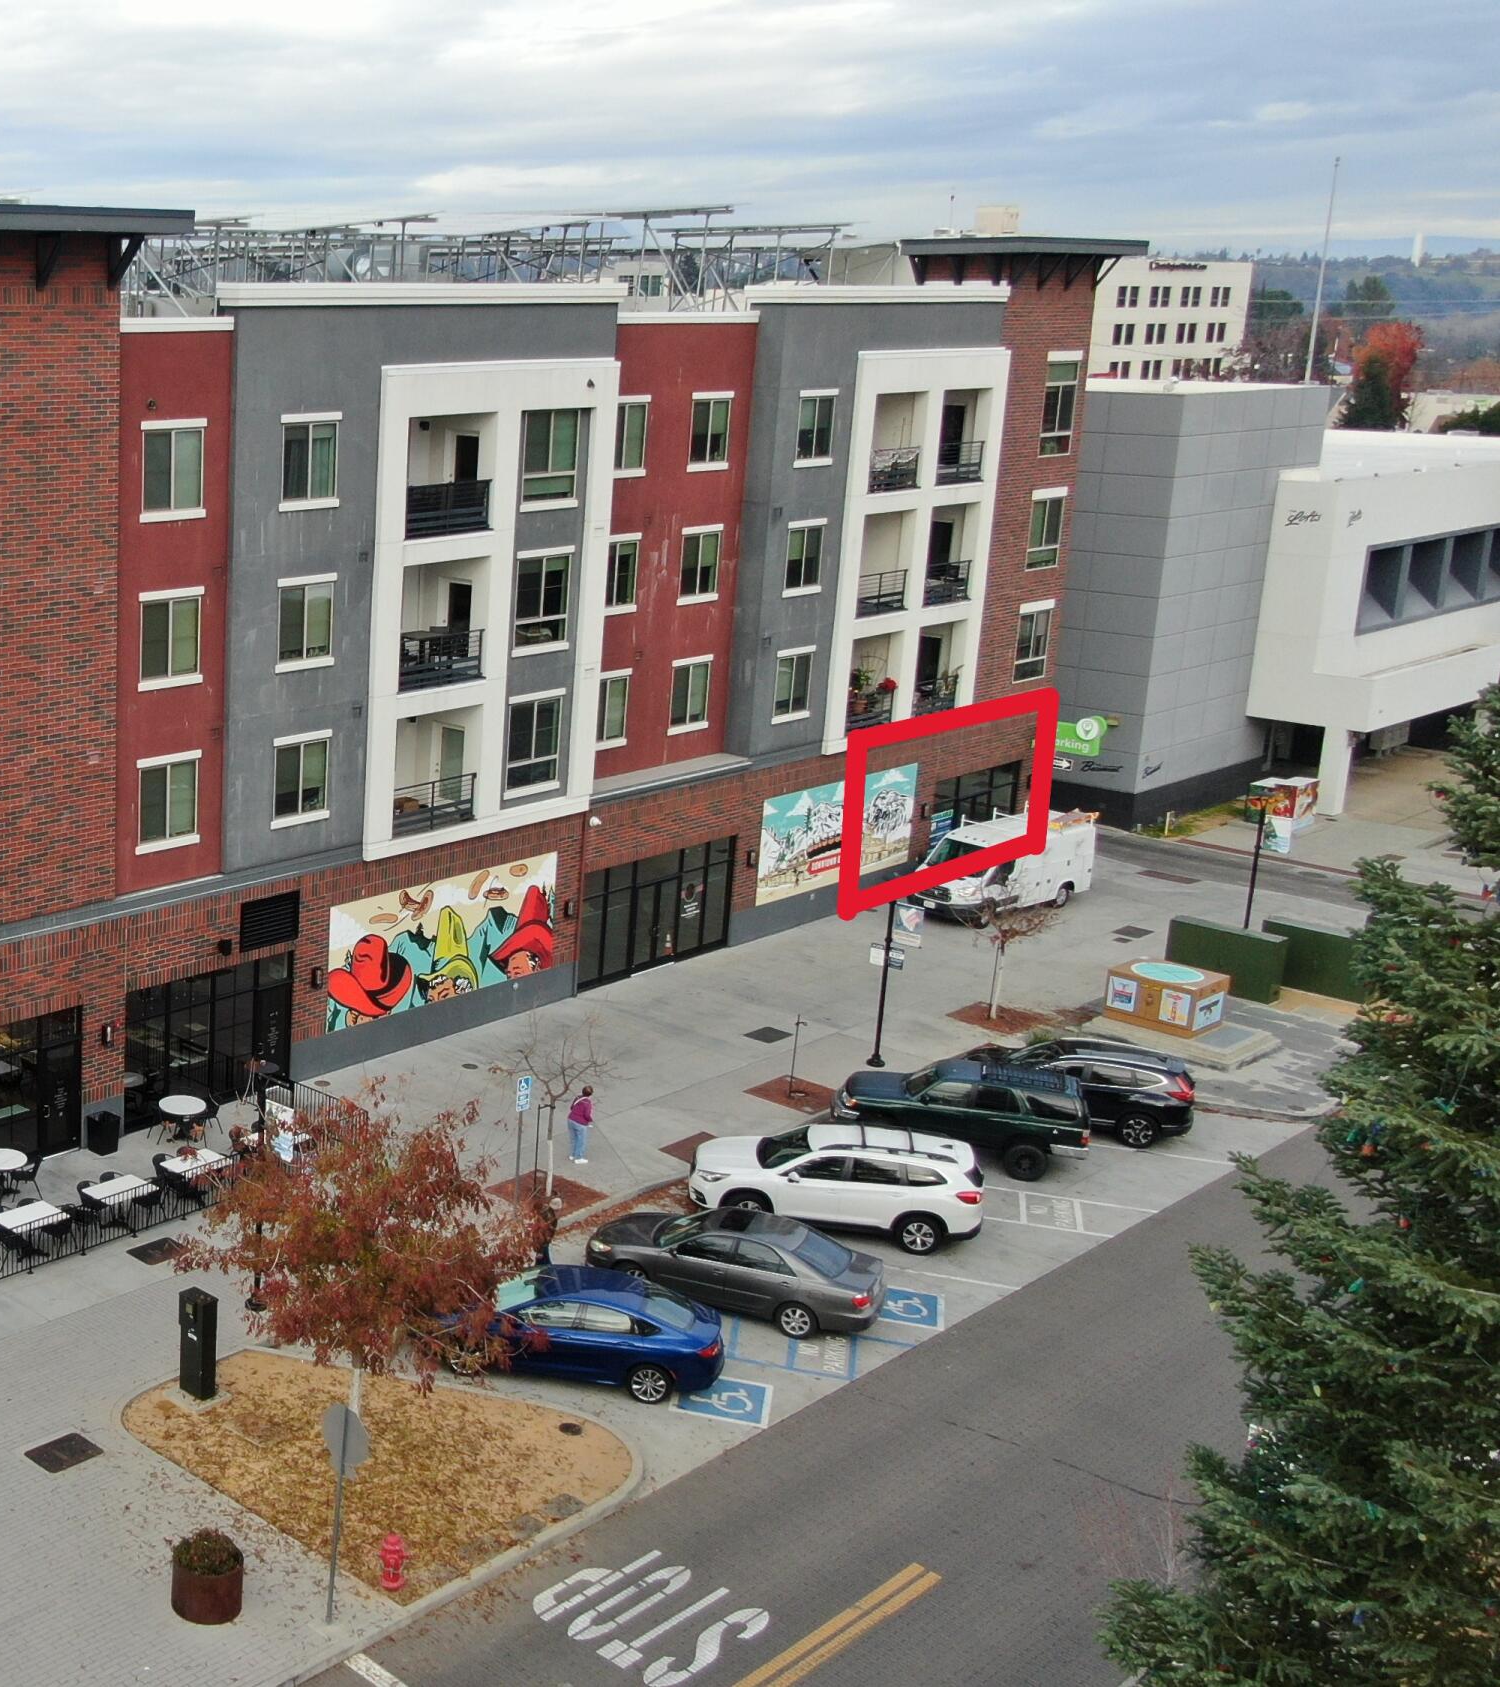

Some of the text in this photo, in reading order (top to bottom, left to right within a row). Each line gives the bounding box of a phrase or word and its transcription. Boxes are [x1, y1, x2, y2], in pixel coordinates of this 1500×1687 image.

[797, 1343, 819, 1357] NO
[822, 1335, 847, 1374] PARKING
[532, 1549, 770, 1687] STOP
